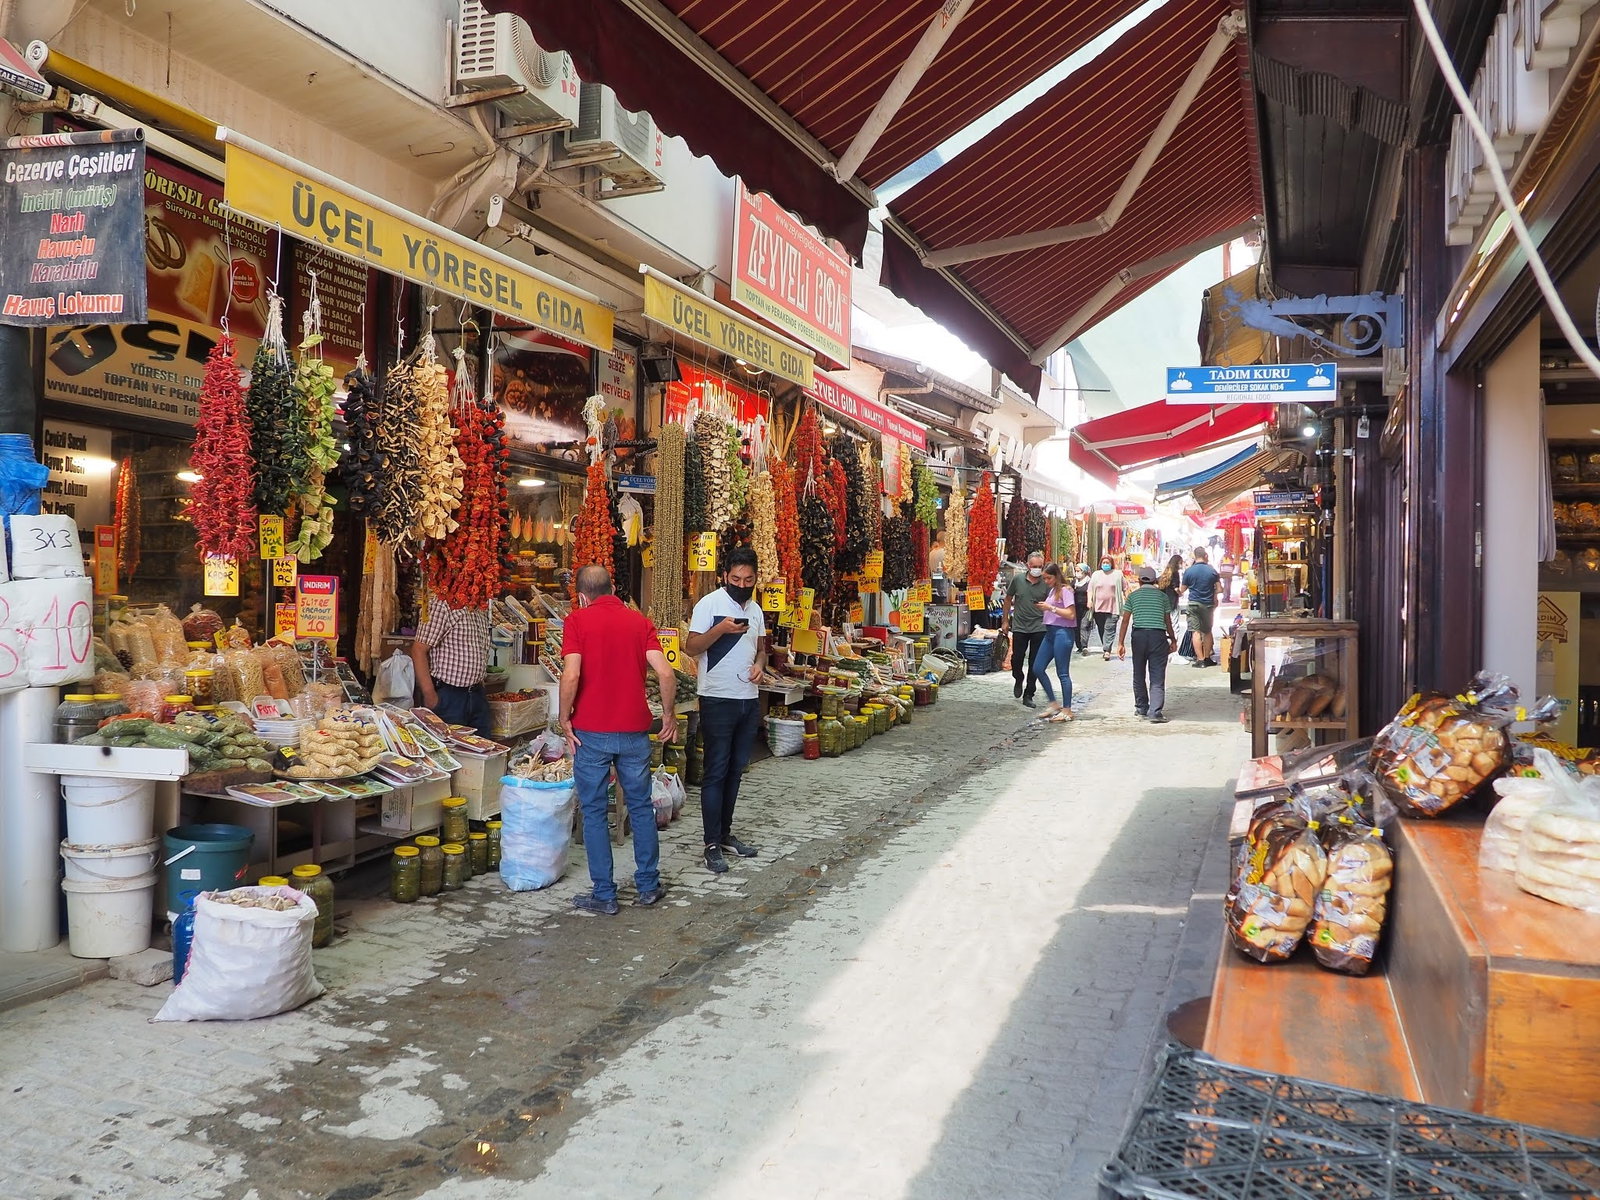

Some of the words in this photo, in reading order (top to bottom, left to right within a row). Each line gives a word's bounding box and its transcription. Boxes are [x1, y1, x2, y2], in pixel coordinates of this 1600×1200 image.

[5, 159, 64, 183] Cezerye
[68, 149, 136, 179] Çeşitleri
[143, 168, 204, 210] ÖRESEL
[50, 211, 86, 234] Narlı
[165, 200, 197, 221] Süreyya
[202, 214, 223, 230] Mutlu
[291, 180, 383, 258] ÜÇEL
[37, 235, 96, 259] Havuçlu
[30, 259, 98, 283] Karadutlu
[298, 275, 336, 294] BEYAZARI
[402, 233, 523, 310] YÖRESEL
[536, 291, 586, 335] GIDA
[2, 294, 55, 318] Havuç
[58, 291, 124, 316] Lokumu
[745, 288, 765, 308] TOPTAN
[771, 306, 797, 329] PERAKENDE
[814, 268, 843, 337] GIDA
[672, 294, 711, 339] ÜÇEL
[720, 320, 775, 367] YÖRESEL
[780, 351, 805, 380] GIDA
[130, 362, 180, 384] YÖRESEL
[607, 358, 626, 375] SEBZE
[1208, 369, 1250, 381] TADIM
[1253, 368, 1291, 380] KURU
[104, 372, 149, 392] TOPTAN
[152, 384, 167, 396] VE
[601, 381, 632, 401] MEYVELER
[613, 375, 620, 385] ve
[1214, 382, 1250, 392] DEMİRCİLER
[1249, 383, 1270, 391] SOKAK
[809, 378, 840, 407] EYVELİ
[840, 392, 858, 416] GIDA
[696, 556, 708, 567] 15
[768, 599, 780, 608] 15
[307, 620, 325, 633] 10
[907, 623, 919, 632] 10
